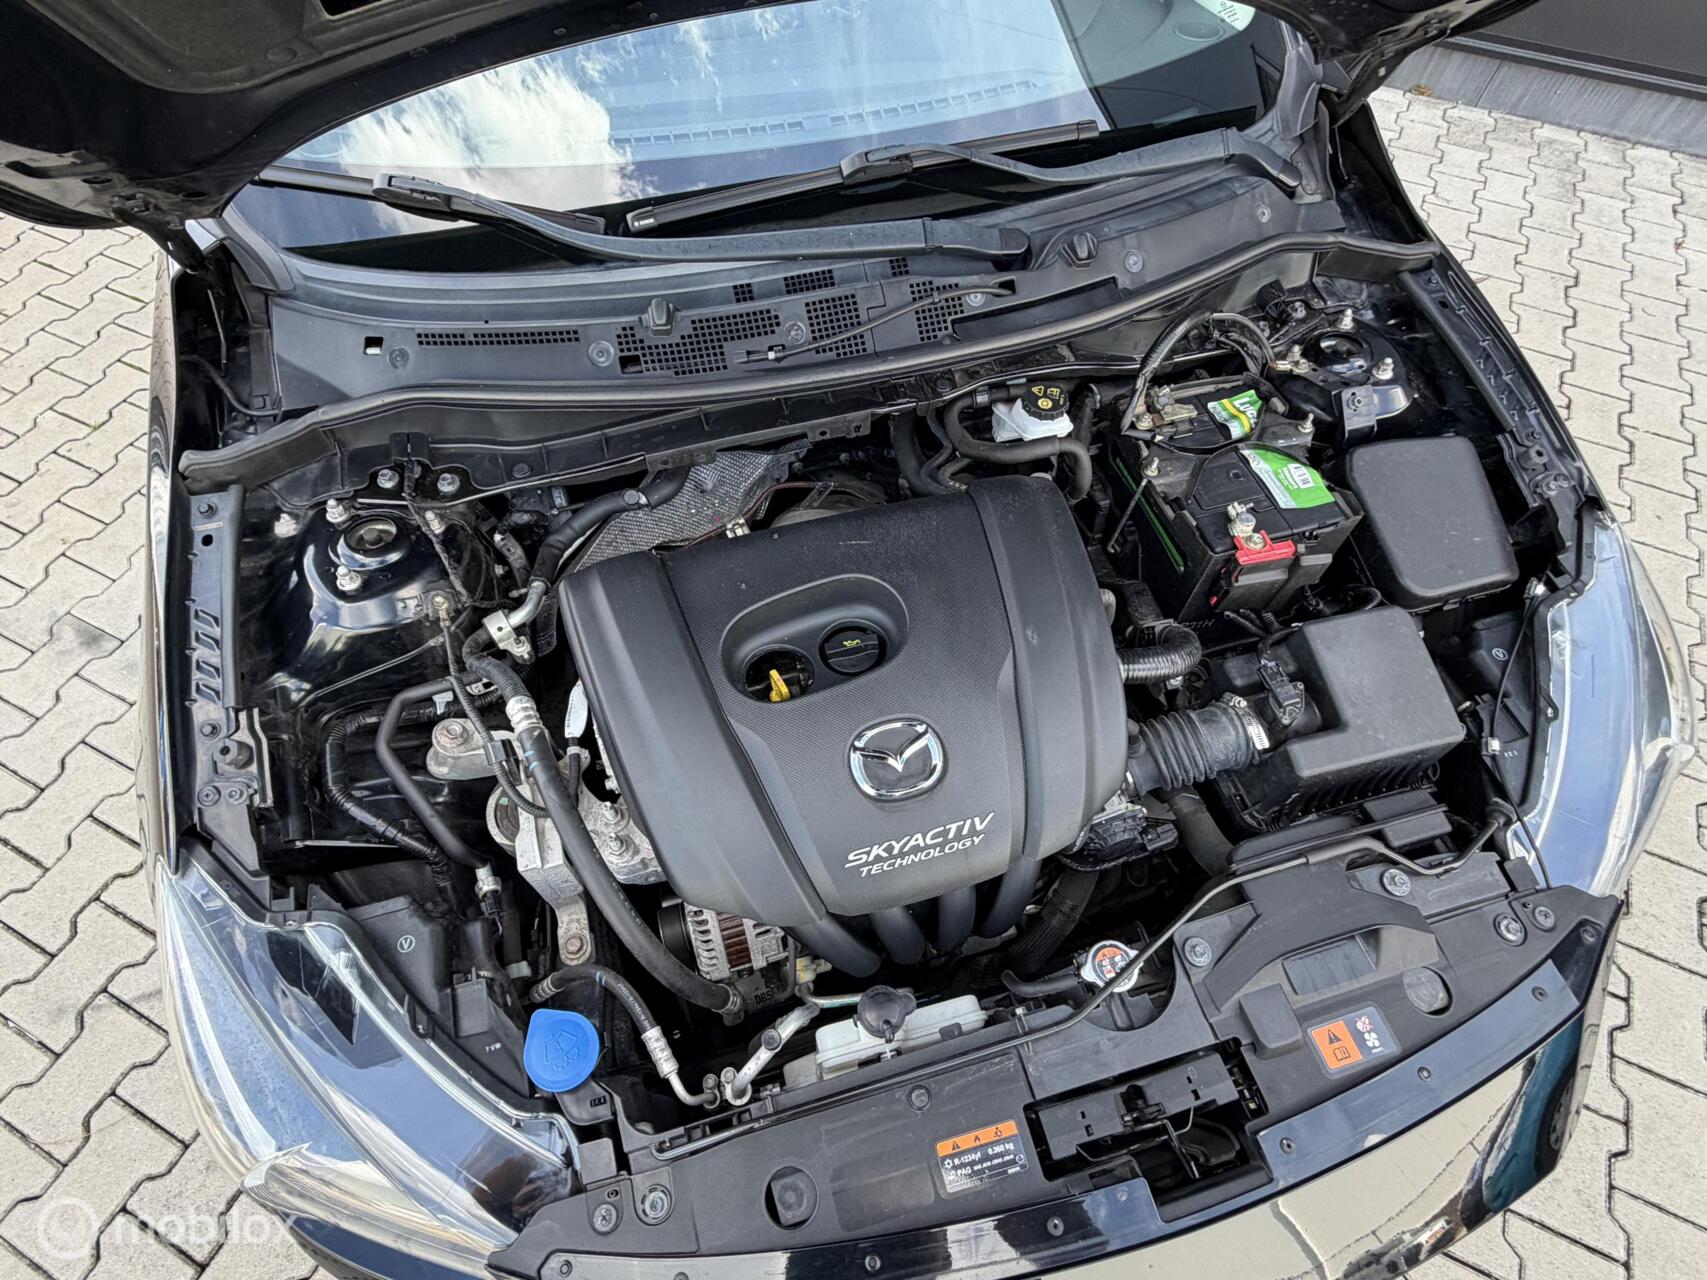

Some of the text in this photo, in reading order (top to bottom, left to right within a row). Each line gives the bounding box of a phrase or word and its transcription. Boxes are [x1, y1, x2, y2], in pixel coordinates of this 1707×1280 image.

[845, 812, 995, 868] SKYACTIV
[860, 834, 985, 877] TECHNOLOGY
[957, 1167, 971, 1177] PAG
